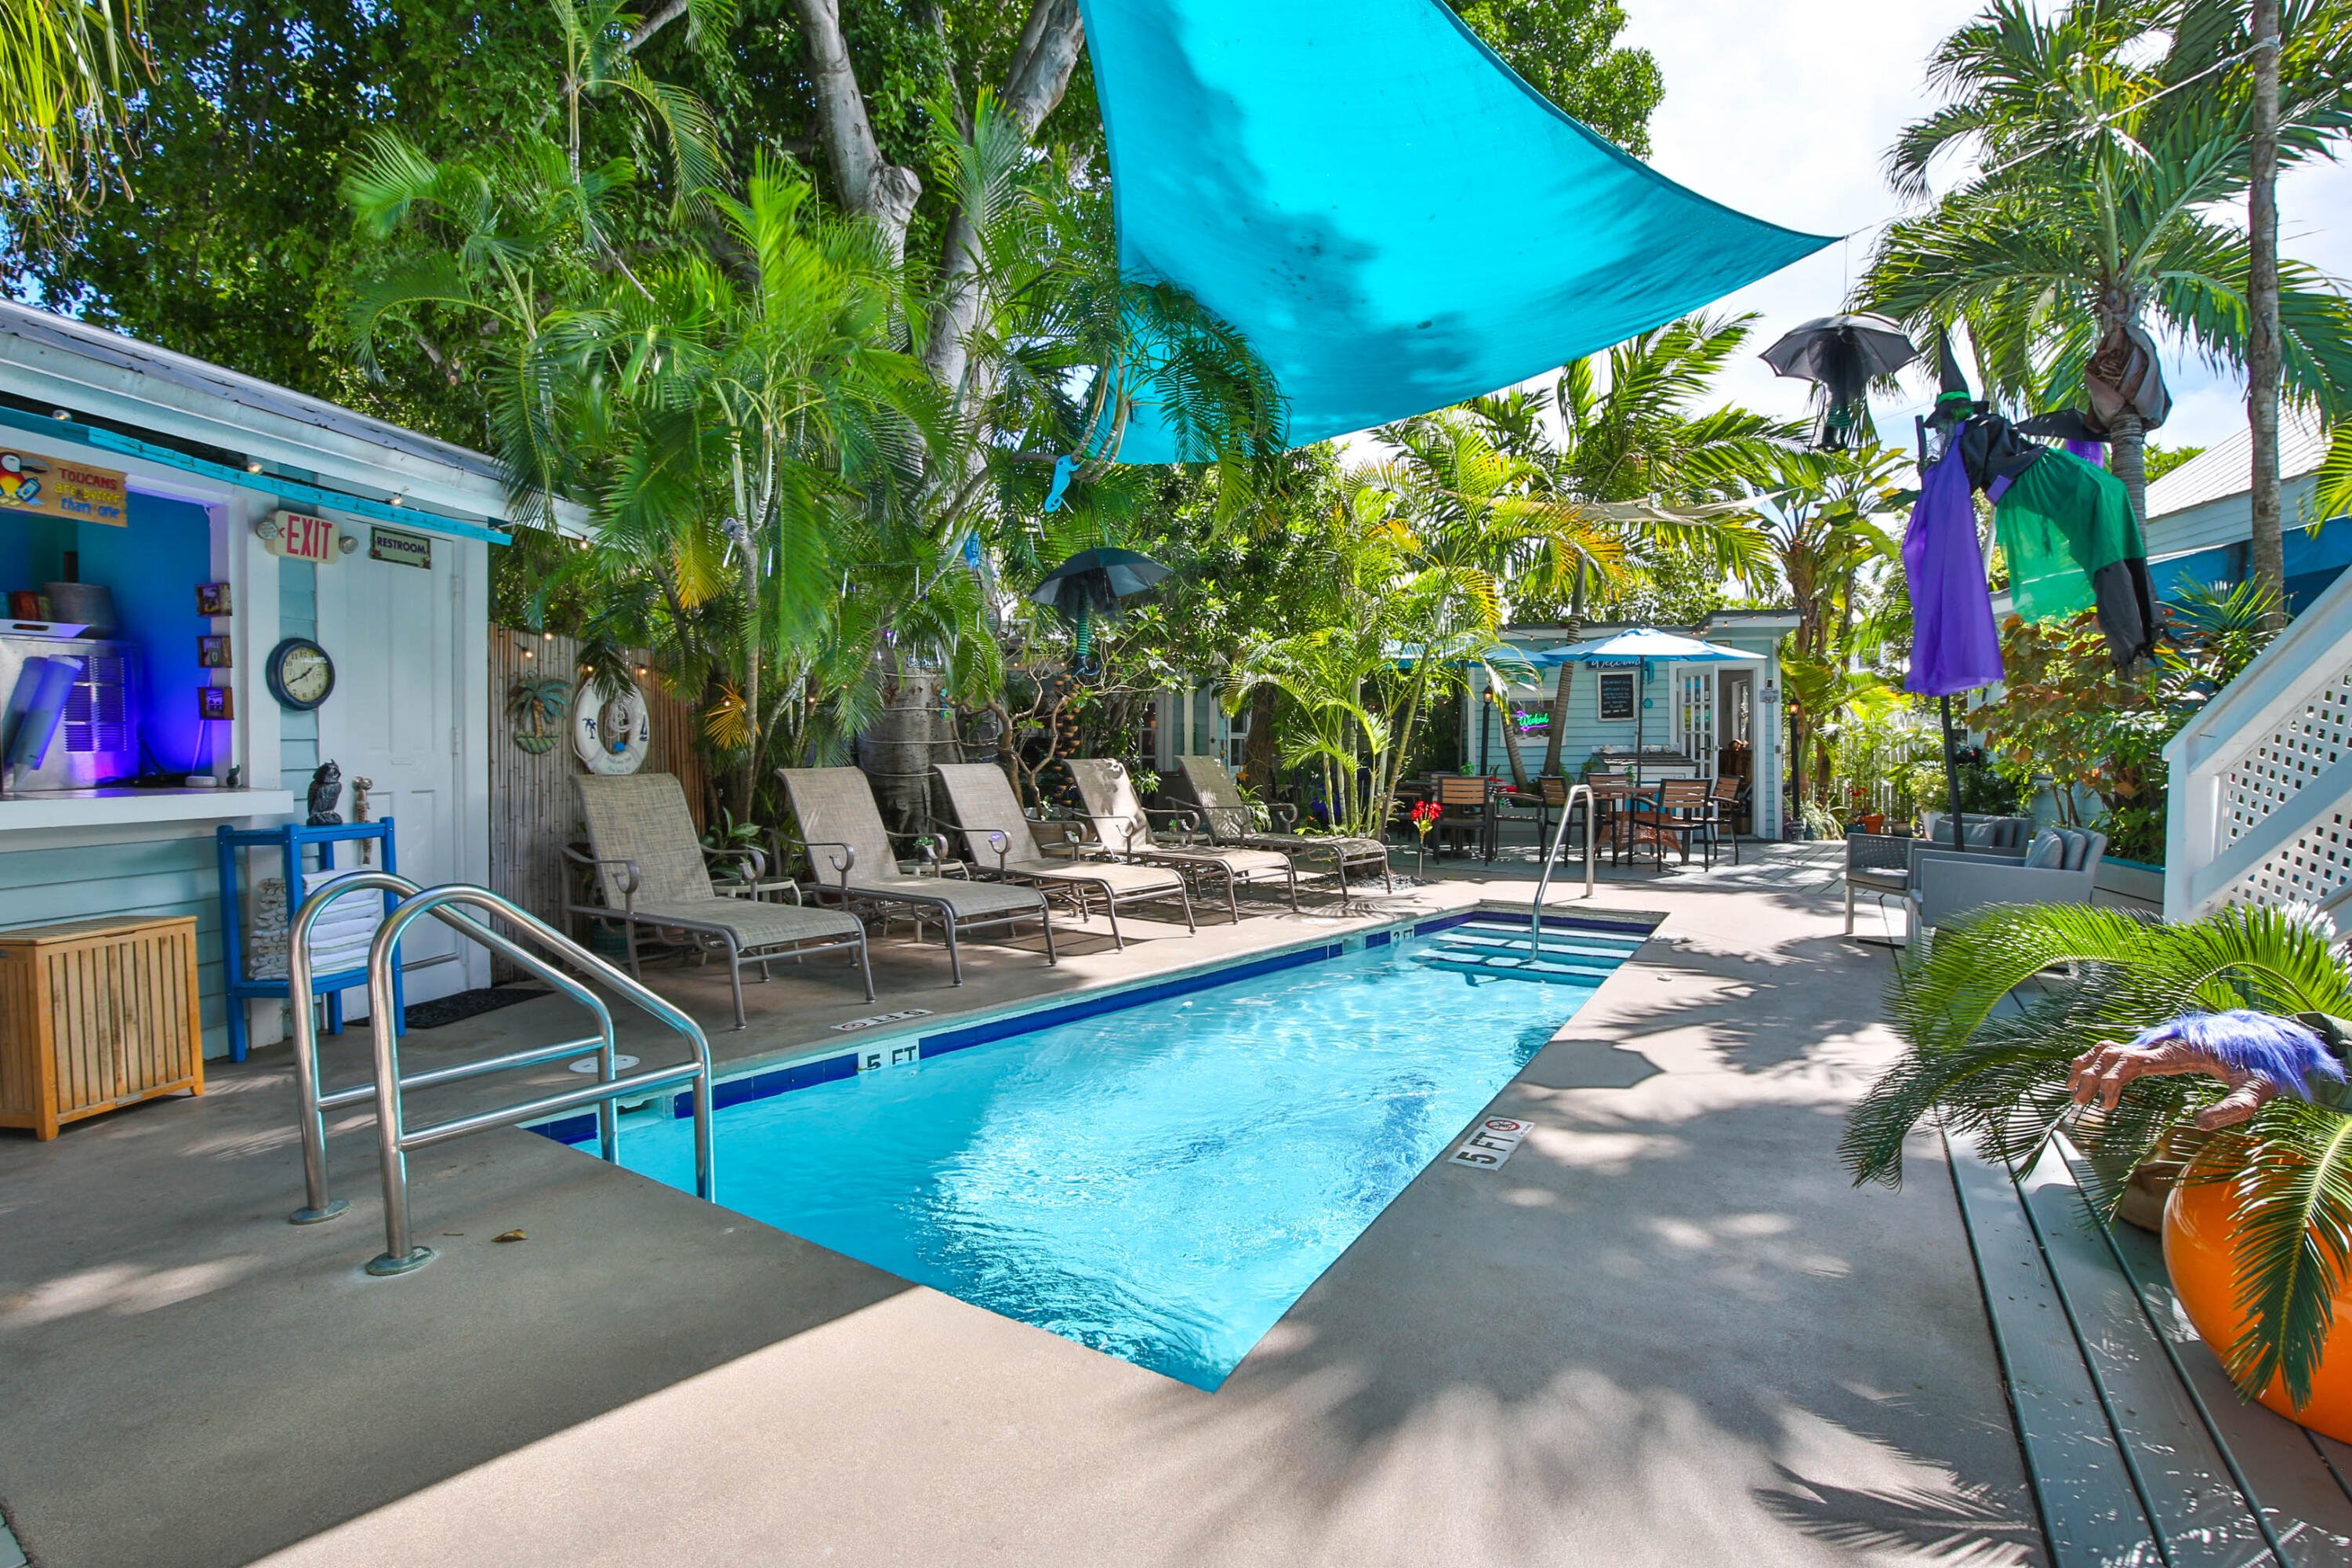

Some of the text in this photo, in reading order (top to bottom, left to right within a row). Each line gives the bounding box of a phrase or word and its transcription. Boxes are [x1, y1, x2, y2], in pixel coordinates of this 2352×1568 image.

[55, 482, 78, 495] are
[58, 467, 117, 490] TOUCANS
[61, 497, 120, 518] than one
[287, 514, 332, 560] EXIT
[376, 535, 426, 554] RESTROOM
[866, 1045, 916, 1071] 5 FT
[1456, 1131, 1515, 1165] 5 FT
